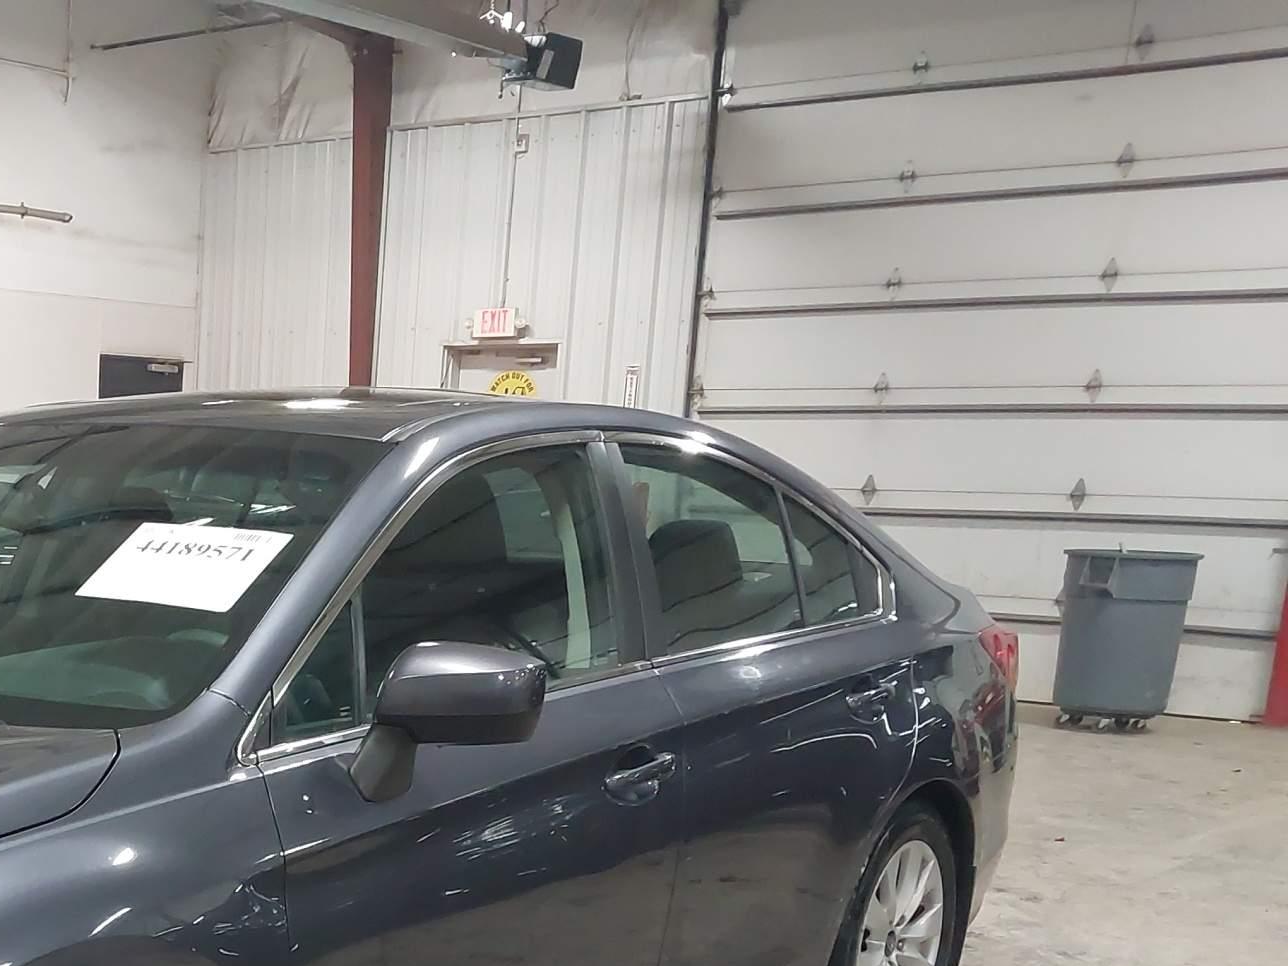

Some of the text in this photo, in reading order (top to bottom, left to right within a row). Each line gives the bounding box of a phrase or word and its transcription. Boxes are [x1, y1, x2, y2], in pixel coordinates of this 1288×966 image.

[481, 310, 508, 334] EXIT
[490, 372, 535, 392] WATCH OUT FOR
[136, 539, 256, 562] 44189571
